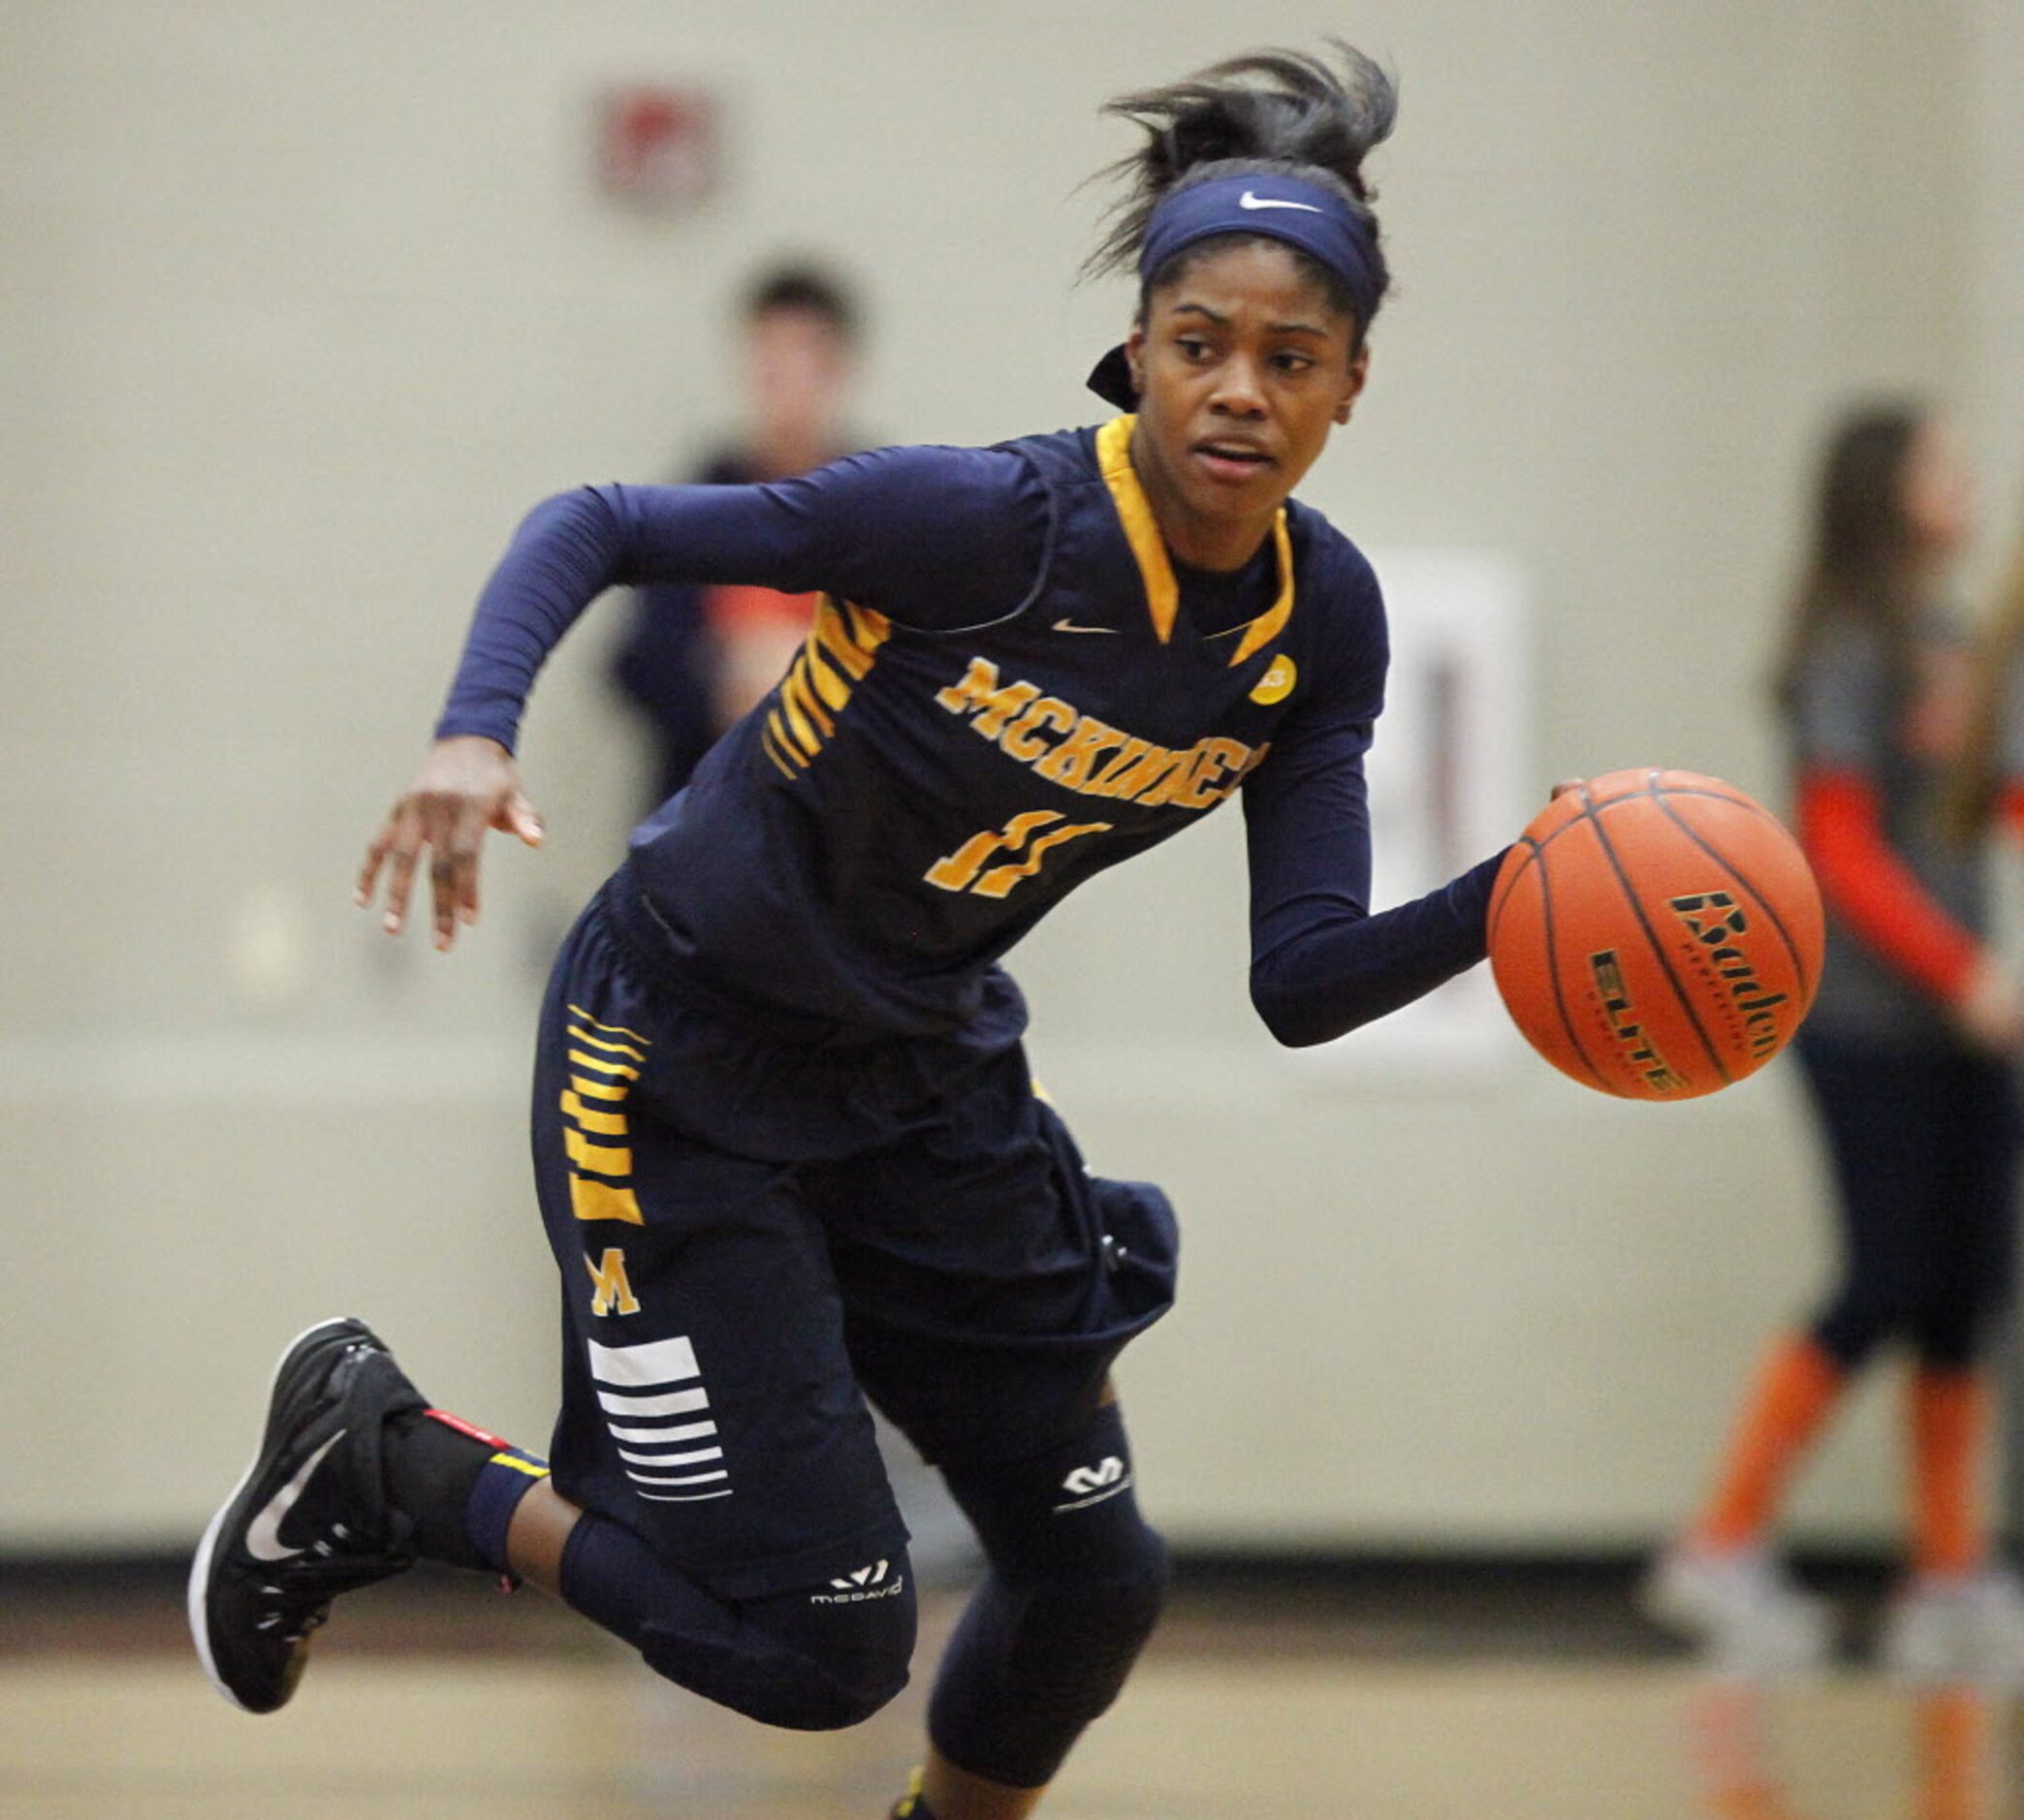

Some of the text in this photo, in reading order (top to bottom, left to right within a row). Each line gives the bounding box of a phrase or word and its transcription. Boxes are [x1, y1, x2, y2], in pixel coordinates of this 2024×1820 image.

[924, 809, 1115, 899] 11
[1589, 948, 1694, 1093] ELITE
[1667, 891, 1787, 1059] Baden
[583, 1246, 642, 1317] M
